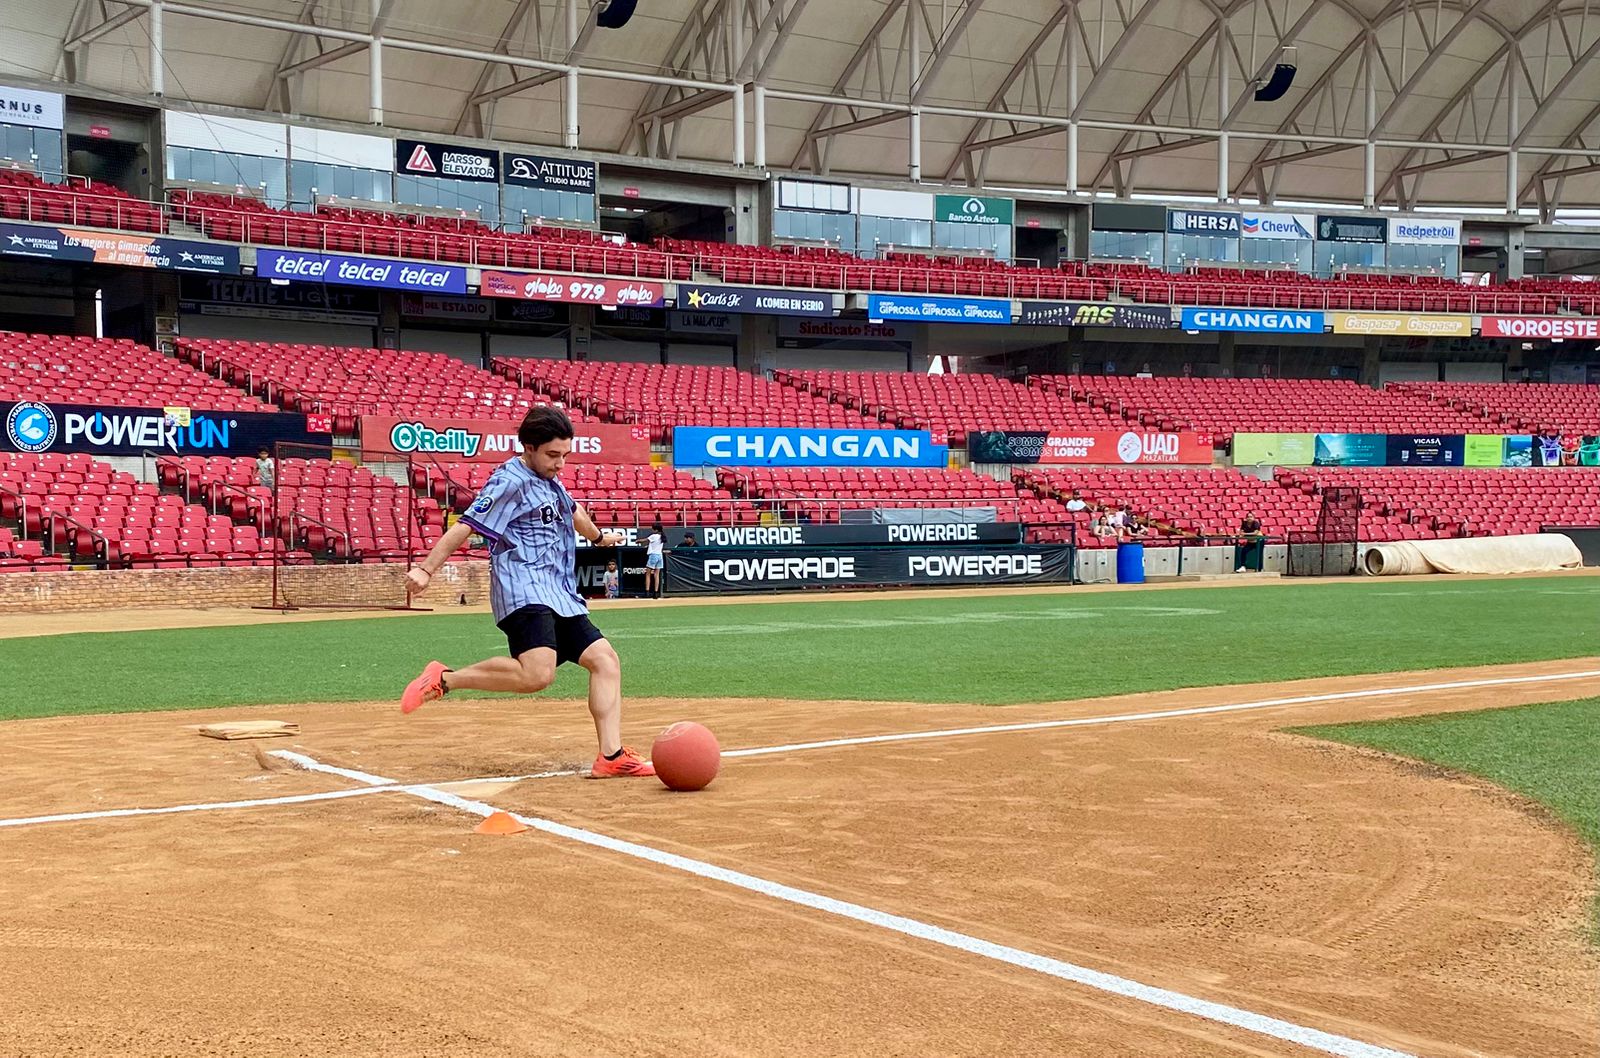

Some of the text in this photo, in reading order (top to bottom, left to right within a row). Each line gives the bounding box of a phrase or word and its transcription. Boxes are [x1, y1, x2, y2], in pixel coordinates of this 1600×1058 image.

[443, 164, 495, 178] ELEVATOR
[540, 160, 594, 180] ATTITUDE
[544, 176, 591, 188] STUDIO BARRE
[948, 213, 999, 224] Banco Azteca
[1187, 214, 1239, 231] HERSA
[24, 237, 58, 245] AMERICAN
[64, 235, 161, 254] Los mejores Gimnasios
[117, 253, 142, 265] mejor
[143, 255, 170, 267] precio
[194, 253, 224, 261] AMERICAN
[274, 255, 450, 287] telcel telcel telcel
[524, 277, 653, 304] globo 97.9 globo
[701, 292, 741, 307] Carl's Jr.
[756, 297, 824, 312] A COMER EN SERIO
[442, 302, 487, 314] ESTADIO
[879, 306, 920, 315] GIPROSSA
[922, 307, 962, 317] GIPROSSA
[964, 309, 1004, 319] GIPROSSA
[1194, 312, 1311, 329] CHANGAN
[1344, 315, 1460, 335] Gaspasa Gaspasa
[1497, 319, 1598, 336] NOROESTE
[799, 321, 896, 337] Sindicato Frito
[33, 403, 52, 419] GROUP
[392, 422, 479, 455] O'Reilly
[1008, 436, 1095, 447] SOMOS GRANDES
[1143, 433, 1179, 455] UAD
[1413, 437, 1442, 446] VICASA
[706, 435, 919, 458] CHANGAN
[1015, 446, 1088, 457] SOMOS LOBOS
[704, 526, 803, 546] POWERADE
[888, 523, 978, 542] POWERADE
[704, 554, 1043, 582] POWERADE POWERADE
